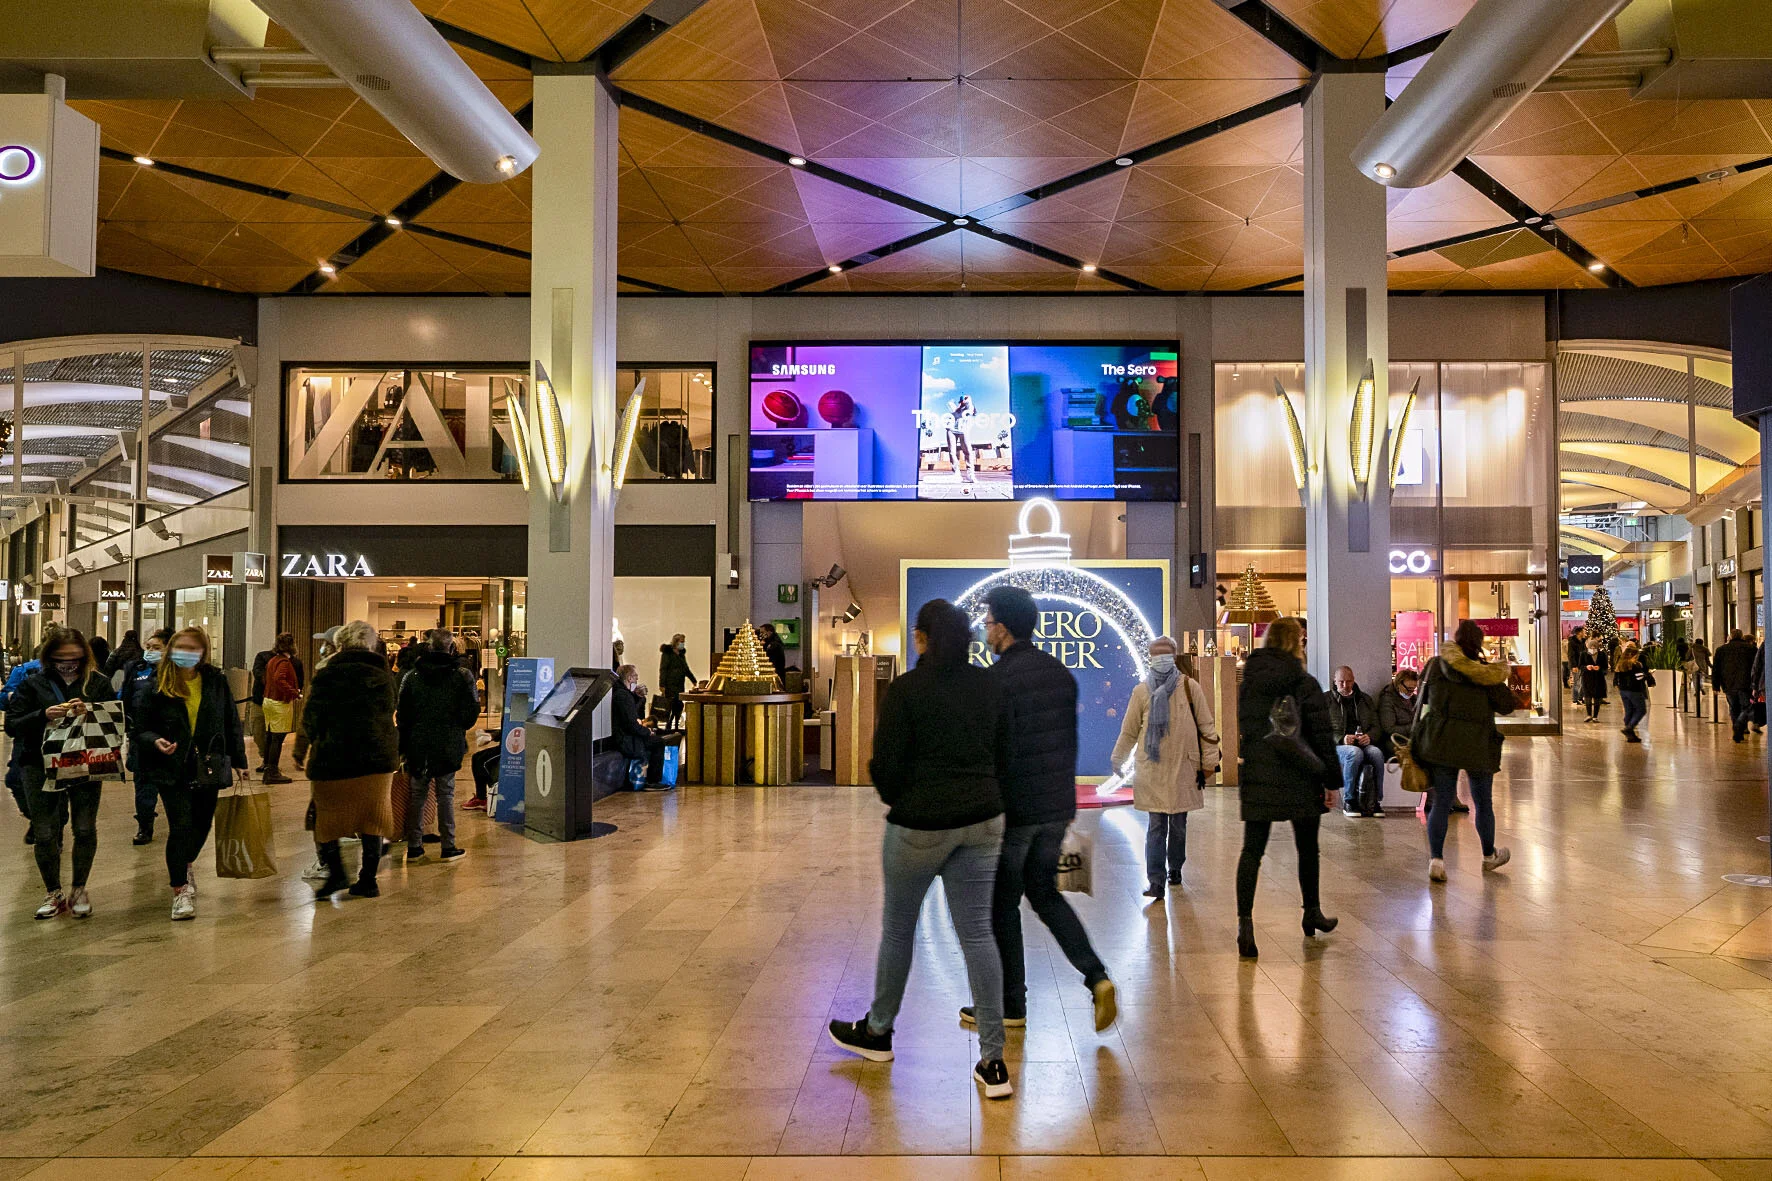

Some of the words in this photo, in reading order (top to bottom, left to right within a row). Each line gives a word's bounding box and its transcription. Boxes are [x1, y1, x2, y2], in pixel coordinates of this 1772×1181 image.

[772, 364, 836, 376] SAMSUNG
[1101, 363, 1125, 375] The
[1127, 363, 1157, 375] Sero
[911, 409, 956, 429] The
[281, 554, 374, 576] ZARA
[1570, 566, 1600, 574] ecco
[245, 568, 264, 577] ZARA
